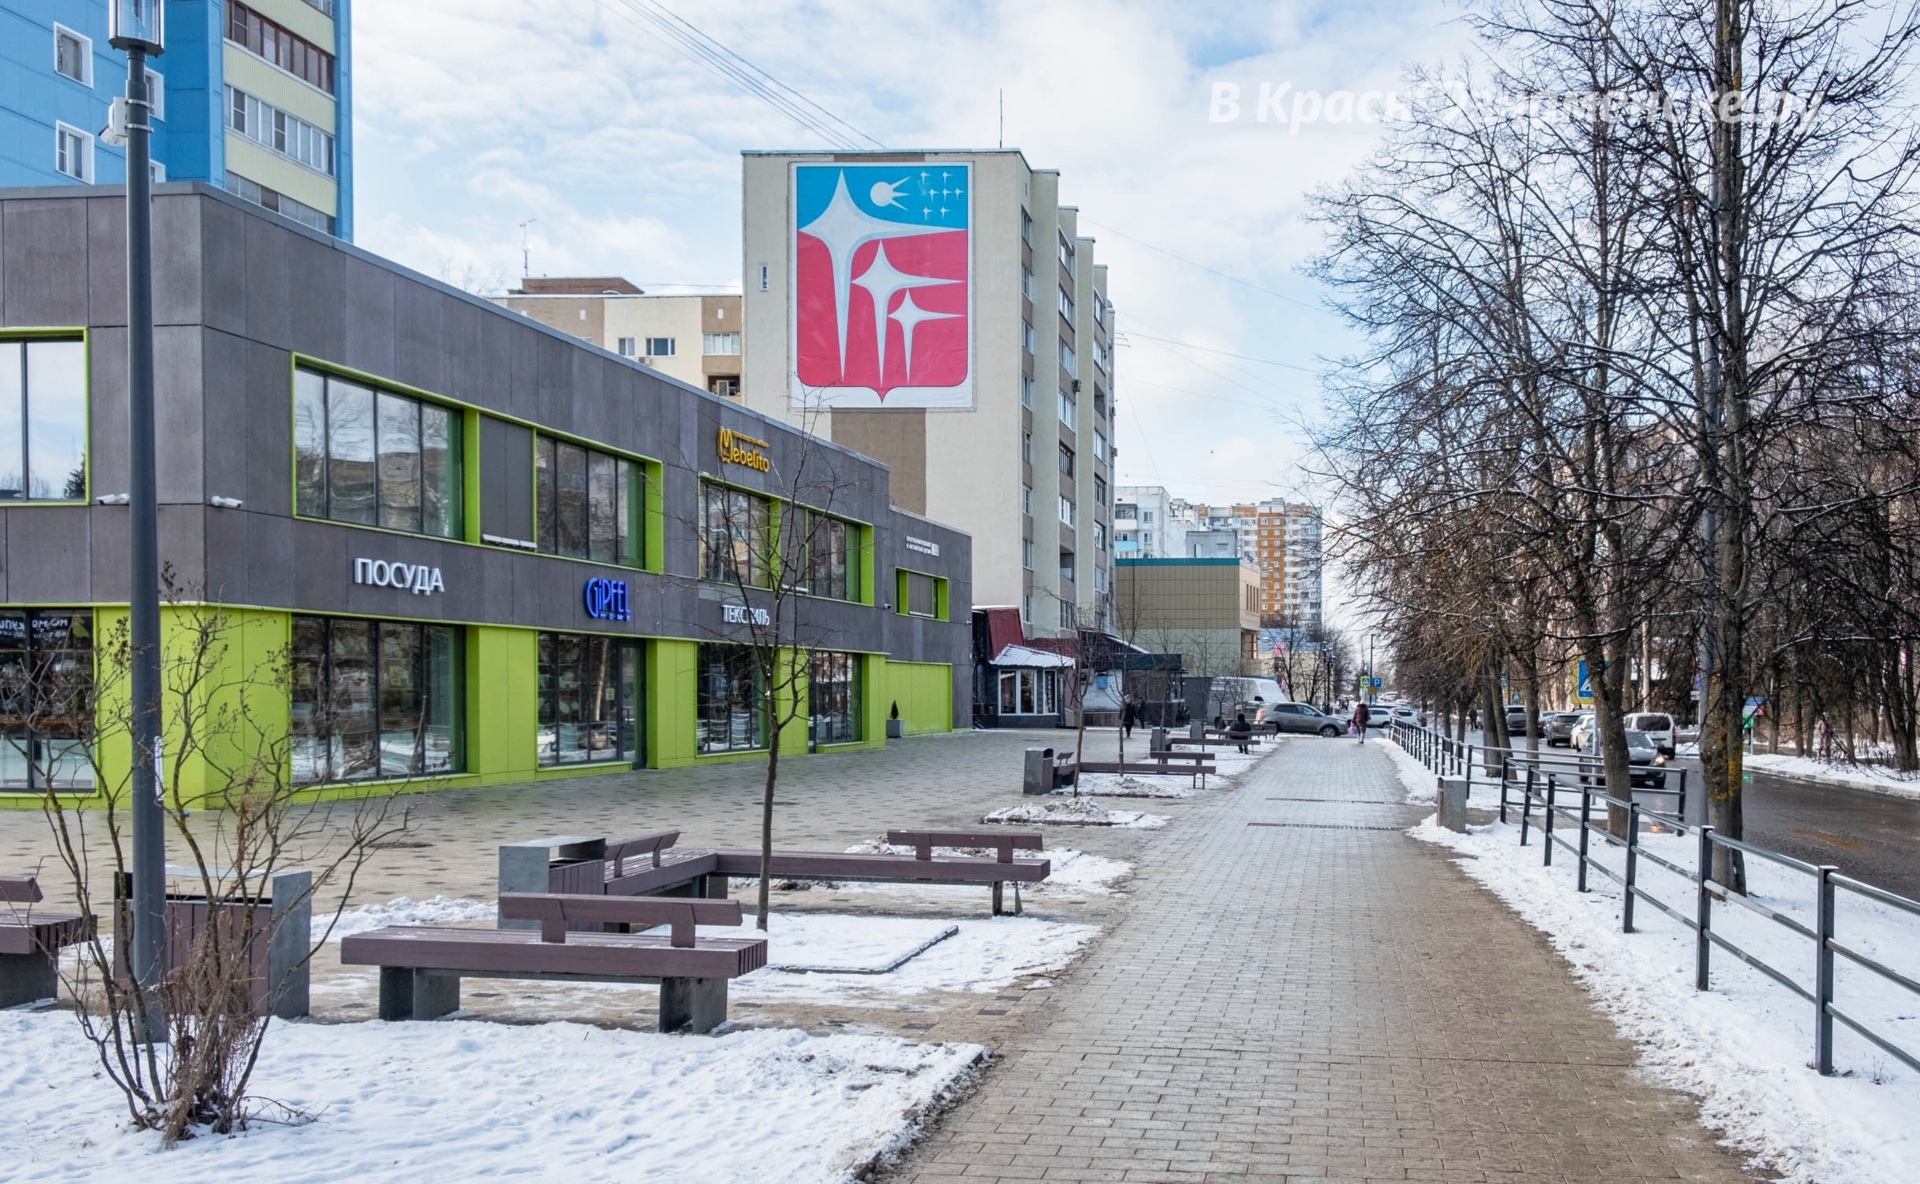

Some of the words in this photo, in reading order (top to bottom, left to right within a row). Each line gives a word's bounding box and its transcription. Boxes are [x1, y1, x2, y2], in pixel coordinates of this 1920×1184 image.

[718, 427, 769, 473] Mebelito
[354, 558, 445, 596] ПОСУДА
[721, 604, 770, 626] ТЕКСИЛЬ
